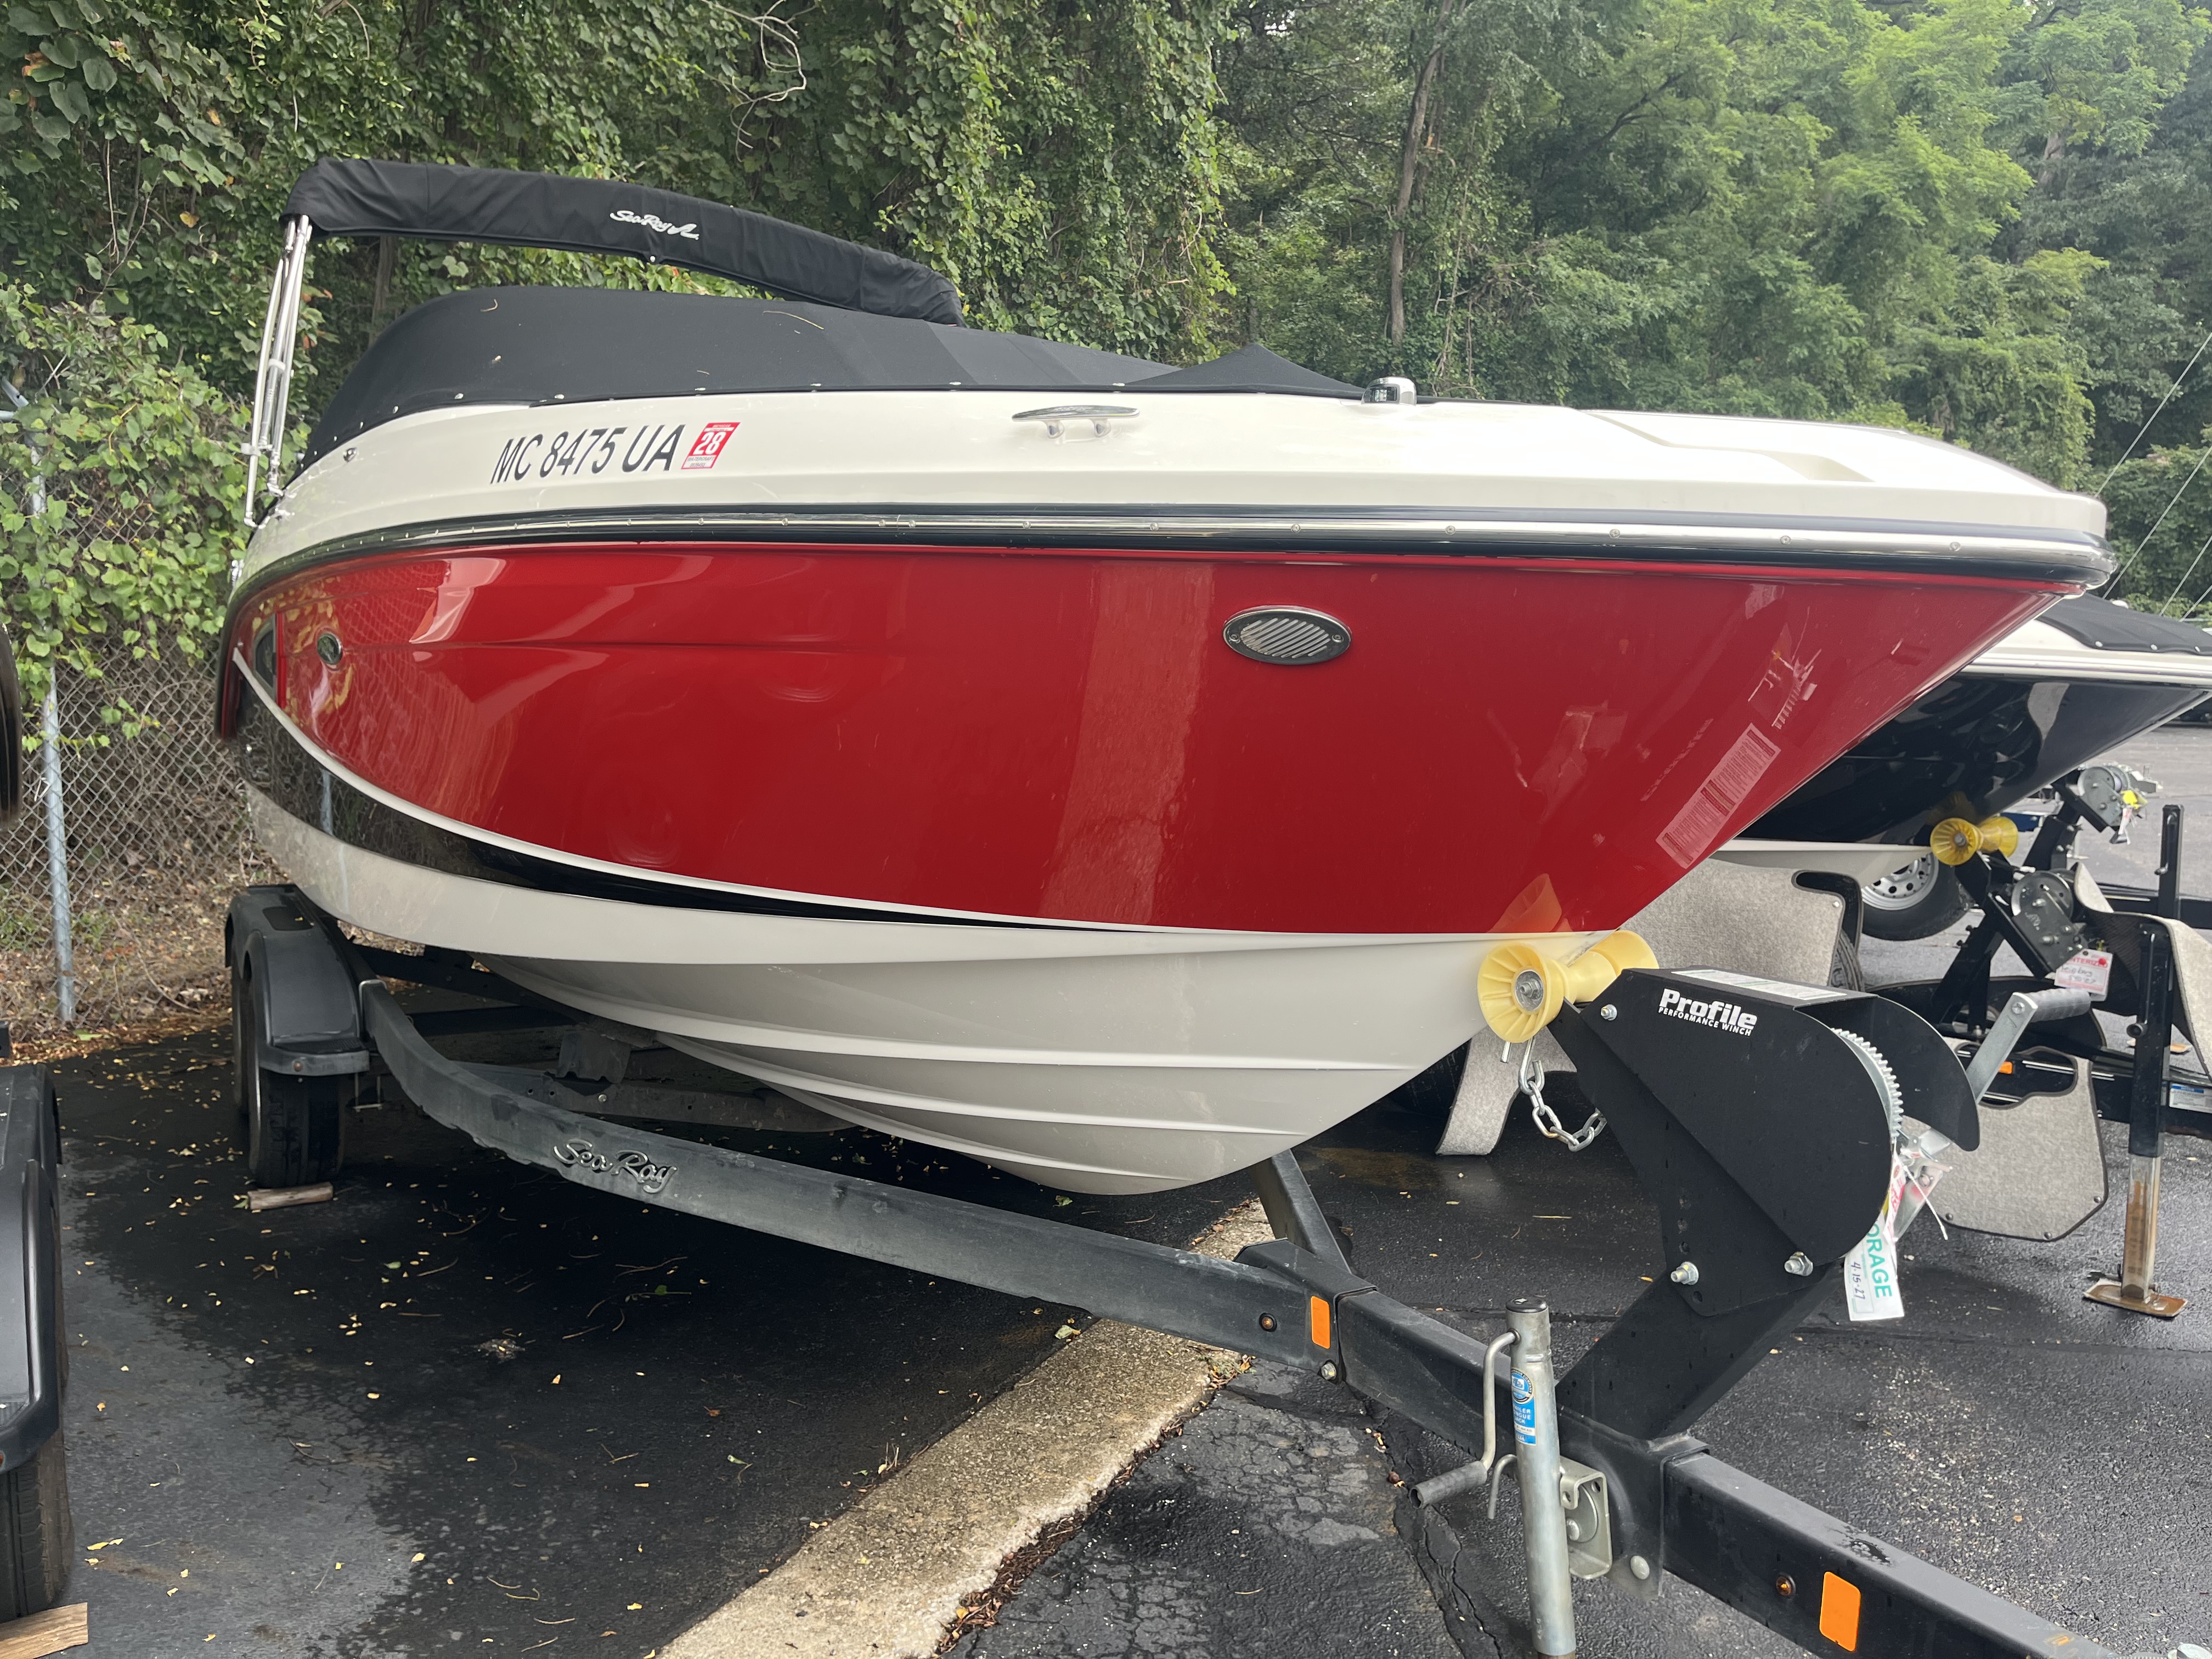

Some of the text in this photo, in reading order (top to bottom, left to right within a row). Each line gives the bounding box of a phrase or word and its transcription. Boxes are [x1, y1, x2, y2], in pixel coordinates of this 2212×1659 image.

[610, 210, 672, 232] Sea Ray
[490, 424, 686, 484] MC 8475 UA
[692, 431, 727, 455] 28
[1658, 1006, 1752, 1036] PERFORMANCE WINCH
[1659, 988, 1758, 1030] Profile
[553, 1138, 678, 1195] Sea Ray
[1866, 1223, 1893, 1299] ORAGE
[1513, 1403, 1531, 1414] AILER
[1514, 1409, 1531, 1420] ONGUE
